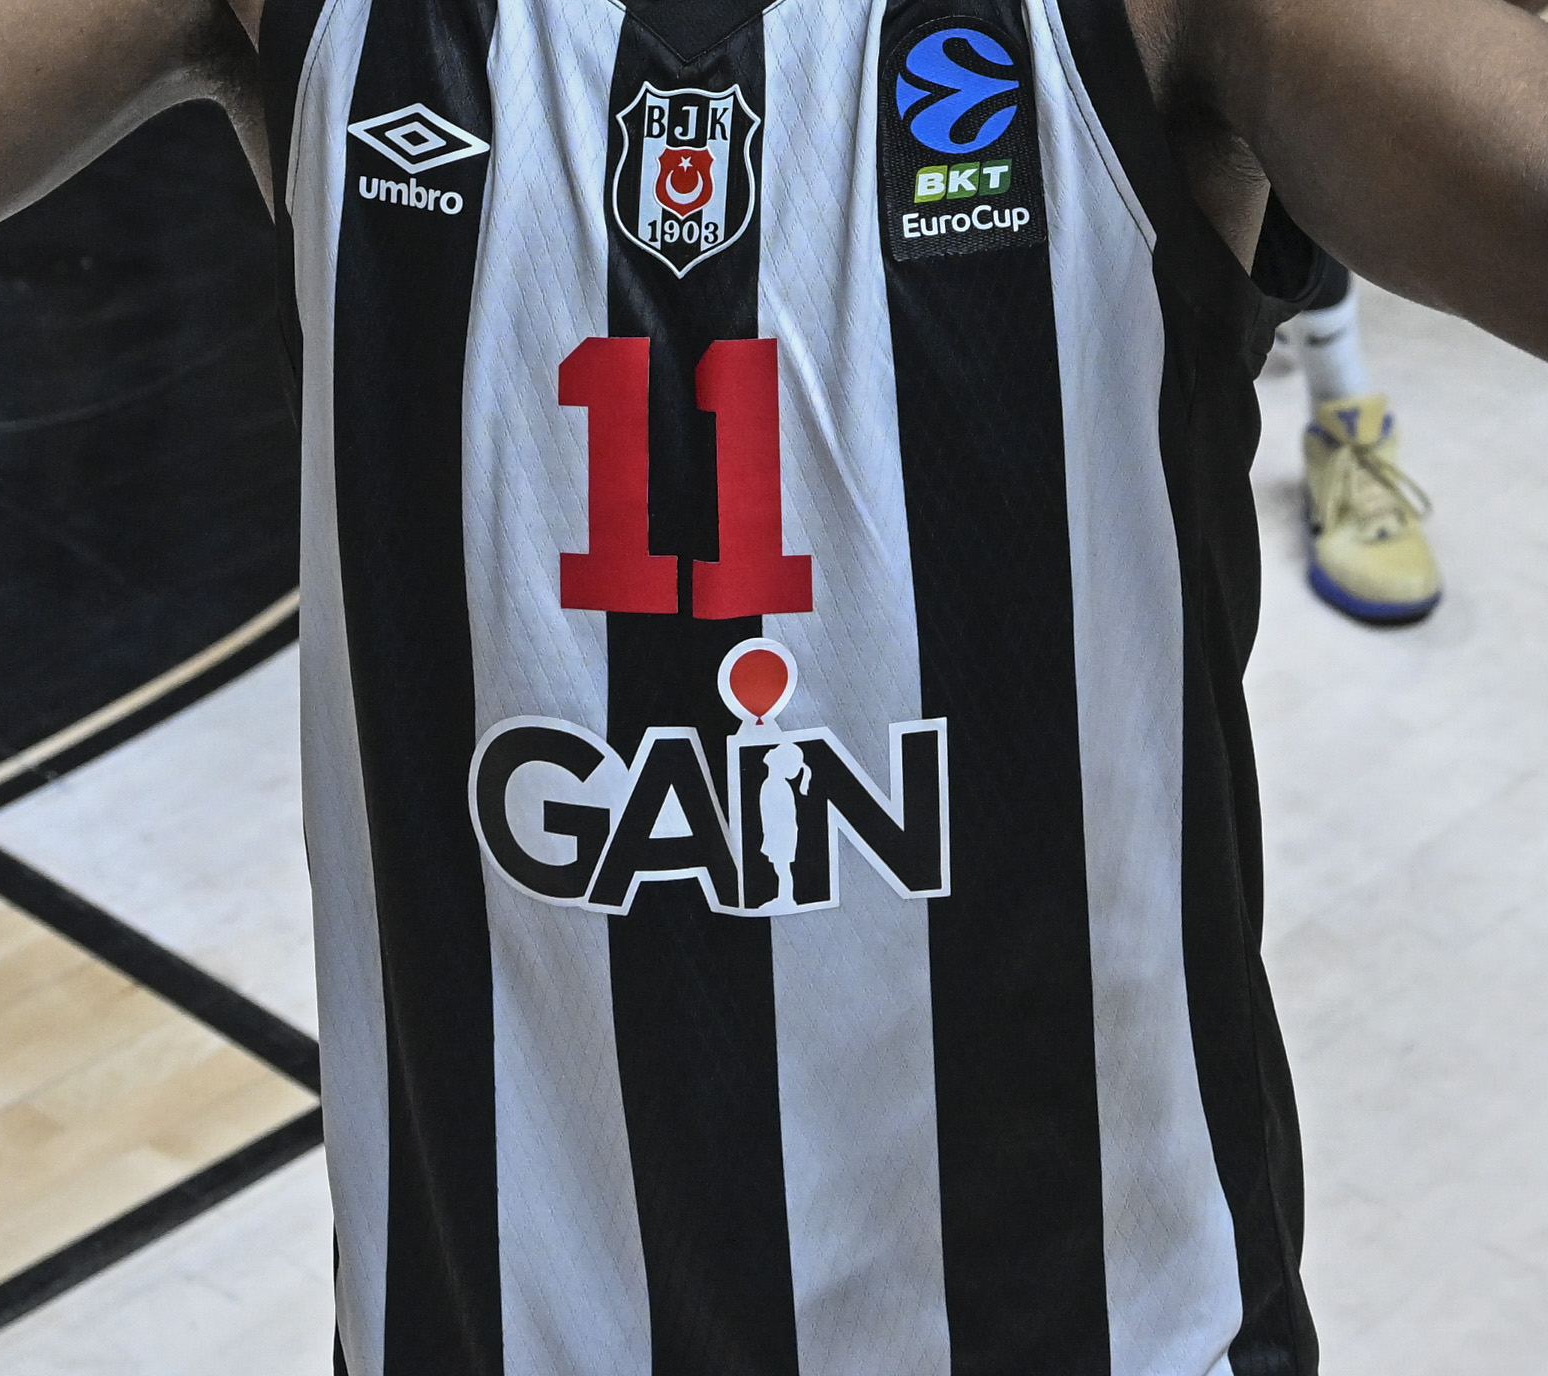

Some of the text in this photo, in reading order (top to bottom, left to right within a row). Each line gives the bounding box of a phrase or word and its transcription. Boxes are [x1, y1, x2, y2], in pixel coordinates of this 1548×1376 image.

[645, 102, 730, 150] BJK
[358, 175, 464, 216] umbro
[917, 162, 1009, 199] BKT
[646, 219, 720, 245] 1903
[901, 204, 1031, 239] EuroCup
[558, 336, 814, 620] 11
